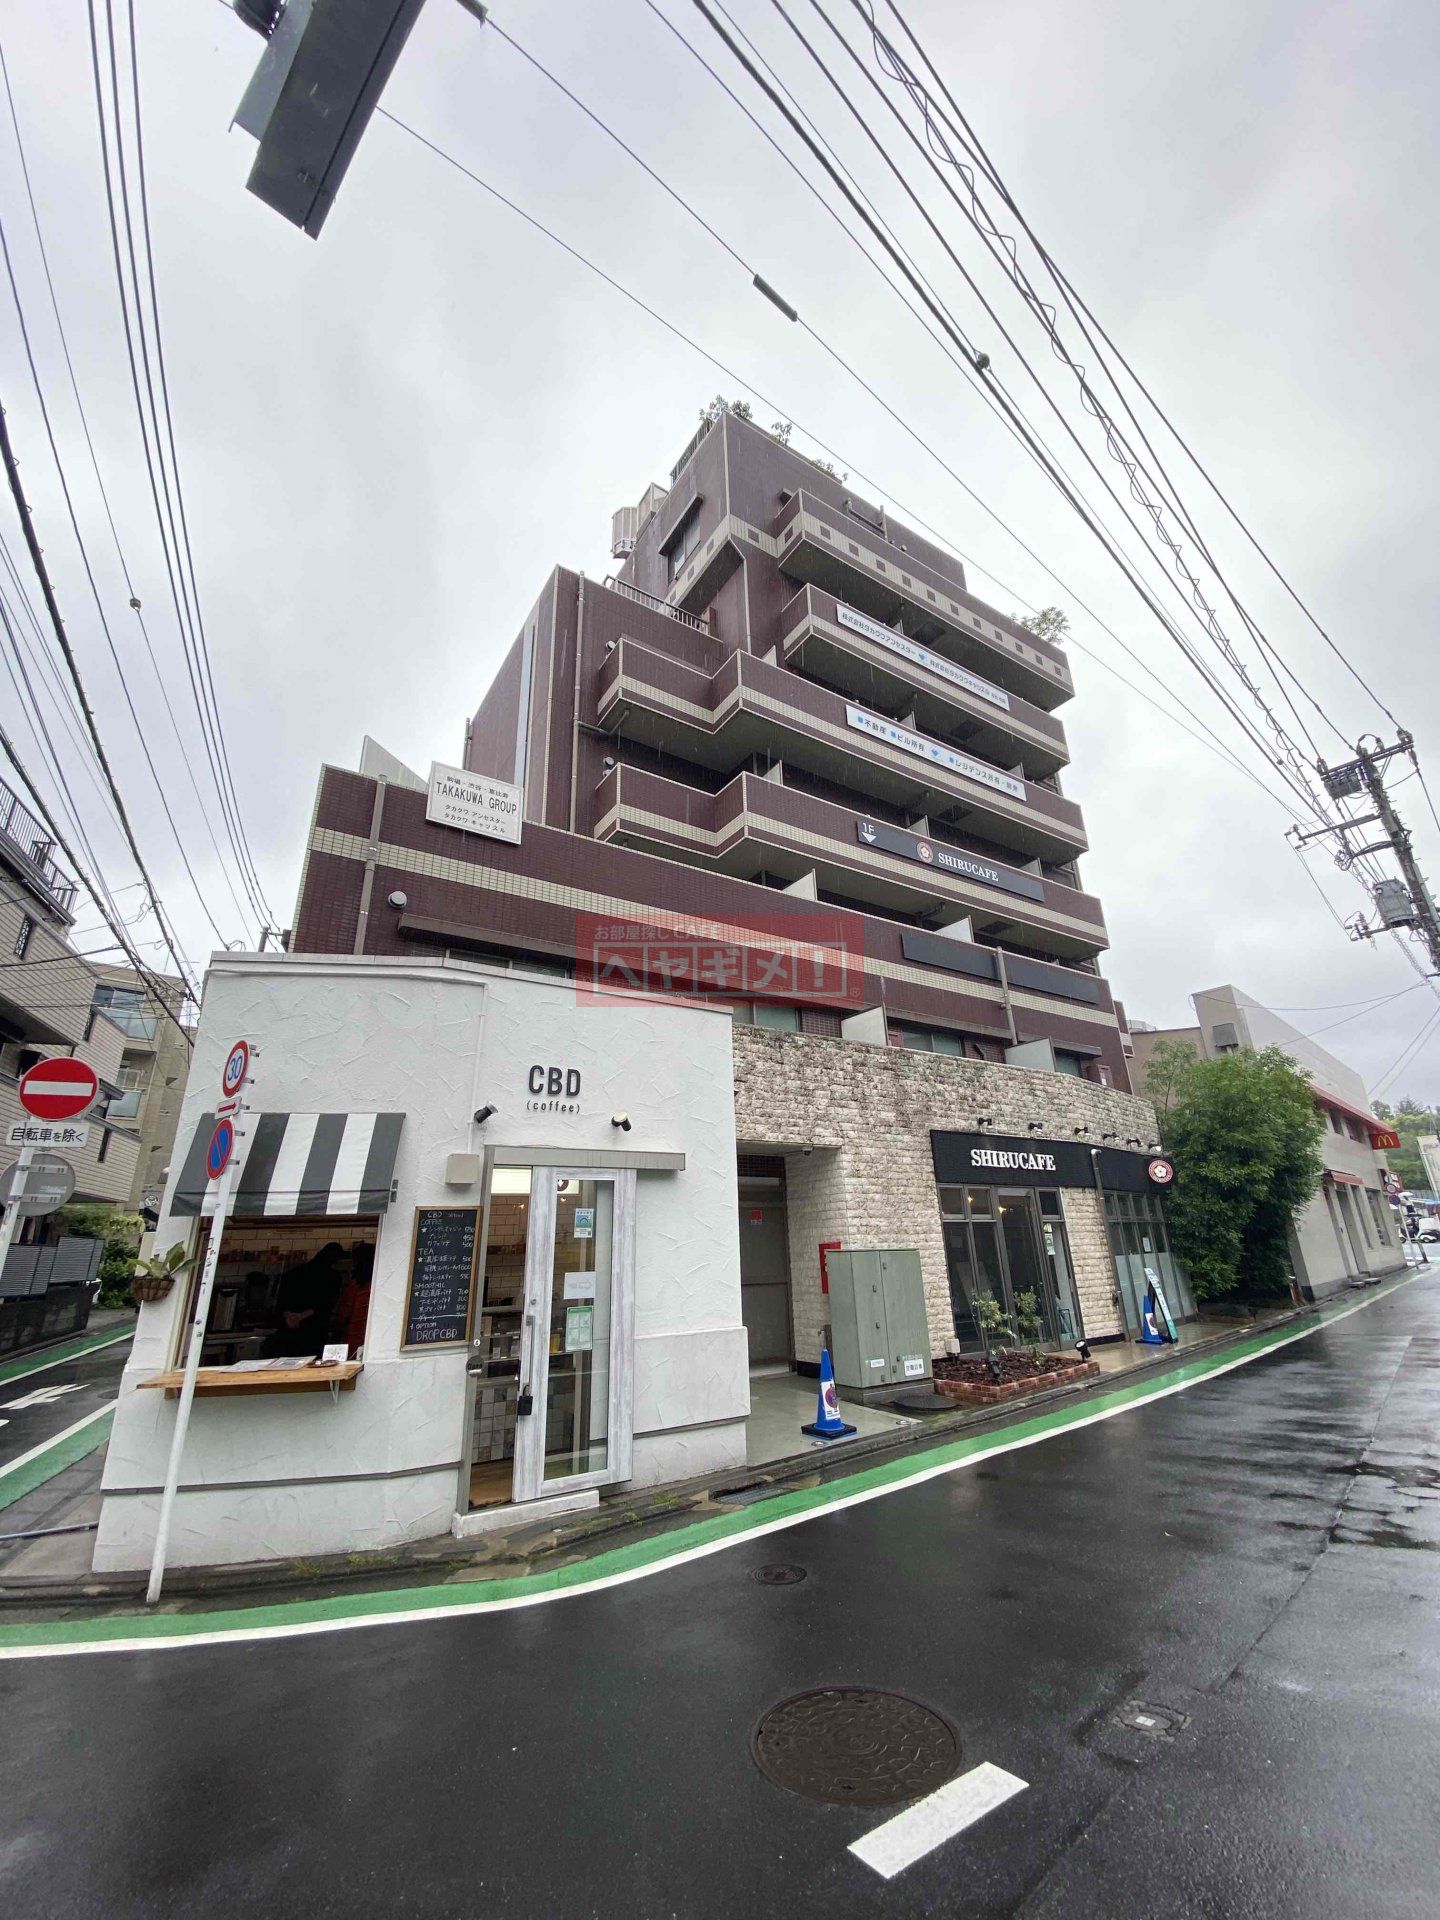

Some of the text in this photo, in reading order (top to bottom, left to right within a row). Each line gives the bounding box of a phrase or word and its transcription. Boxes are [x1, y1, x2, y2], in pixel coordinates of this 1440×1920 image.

[897, 734, 925, 752] ビル所有
[436, 781, 517, 815] TAKAKUWA GROUP
[444, 813, 468, 824] タカクワ
[445, 804, 507, 824] タカクワ アンセスター
[862, 822, 875, 834] 1F
[938, 852, 999, 882] SHIRUCAFE
[227, 1056, 243, 1082] 30
[528, 1064, 581, 1096] CBD
[526, 1100, 580, 1114] (coffee)
[11, 1127, 84, 1143] 自転車を除く
[970, 1149, 1056, 1171] SHIRUCAFE
[418, 1248, 434, 1256] TEA
[440, 1328, 458, 1339] CBD
